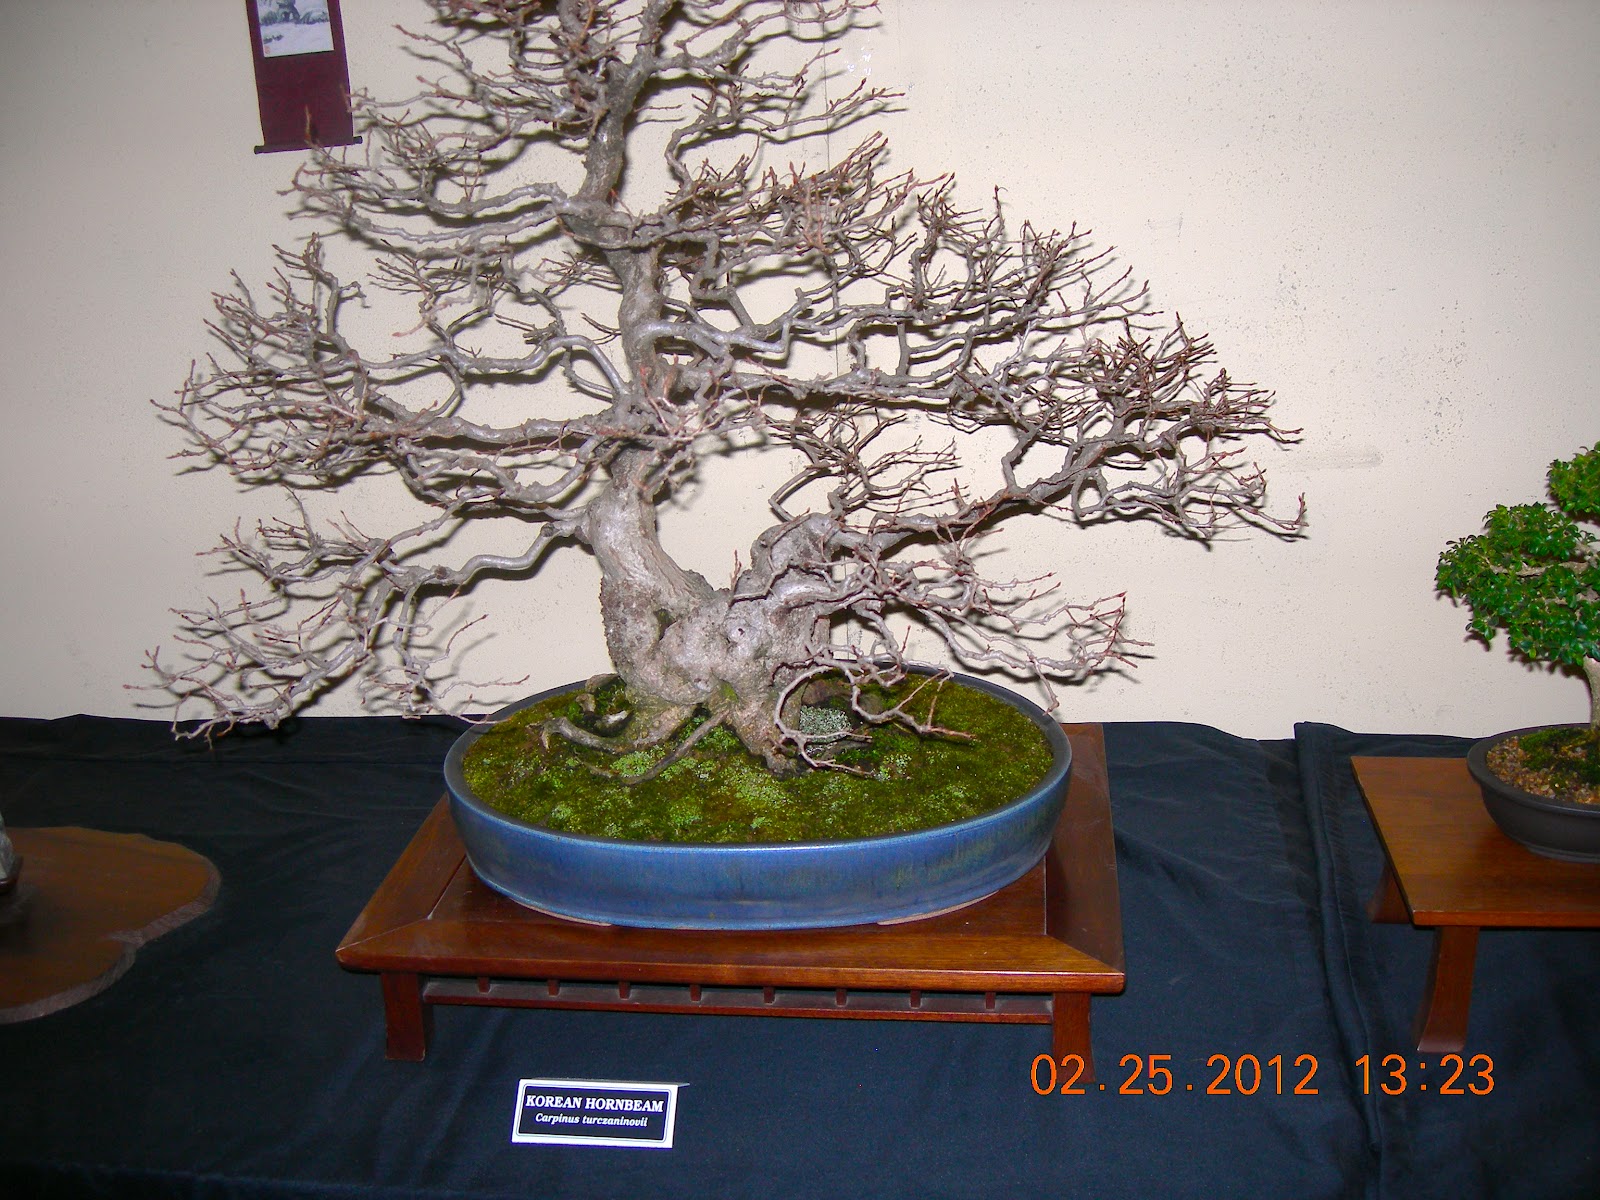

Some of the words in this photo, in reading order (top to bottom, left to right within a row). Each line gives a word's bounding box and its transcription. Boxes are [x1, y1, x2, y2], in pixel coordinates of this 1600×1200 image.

[525, 1095, 582, 1109] KOREAN
[585, 1097, 664, 1112] HORNBEAM
[535, 1112, 580, 1125] Carpinus
[582, 1115, 648, 1127] turczaninovii
